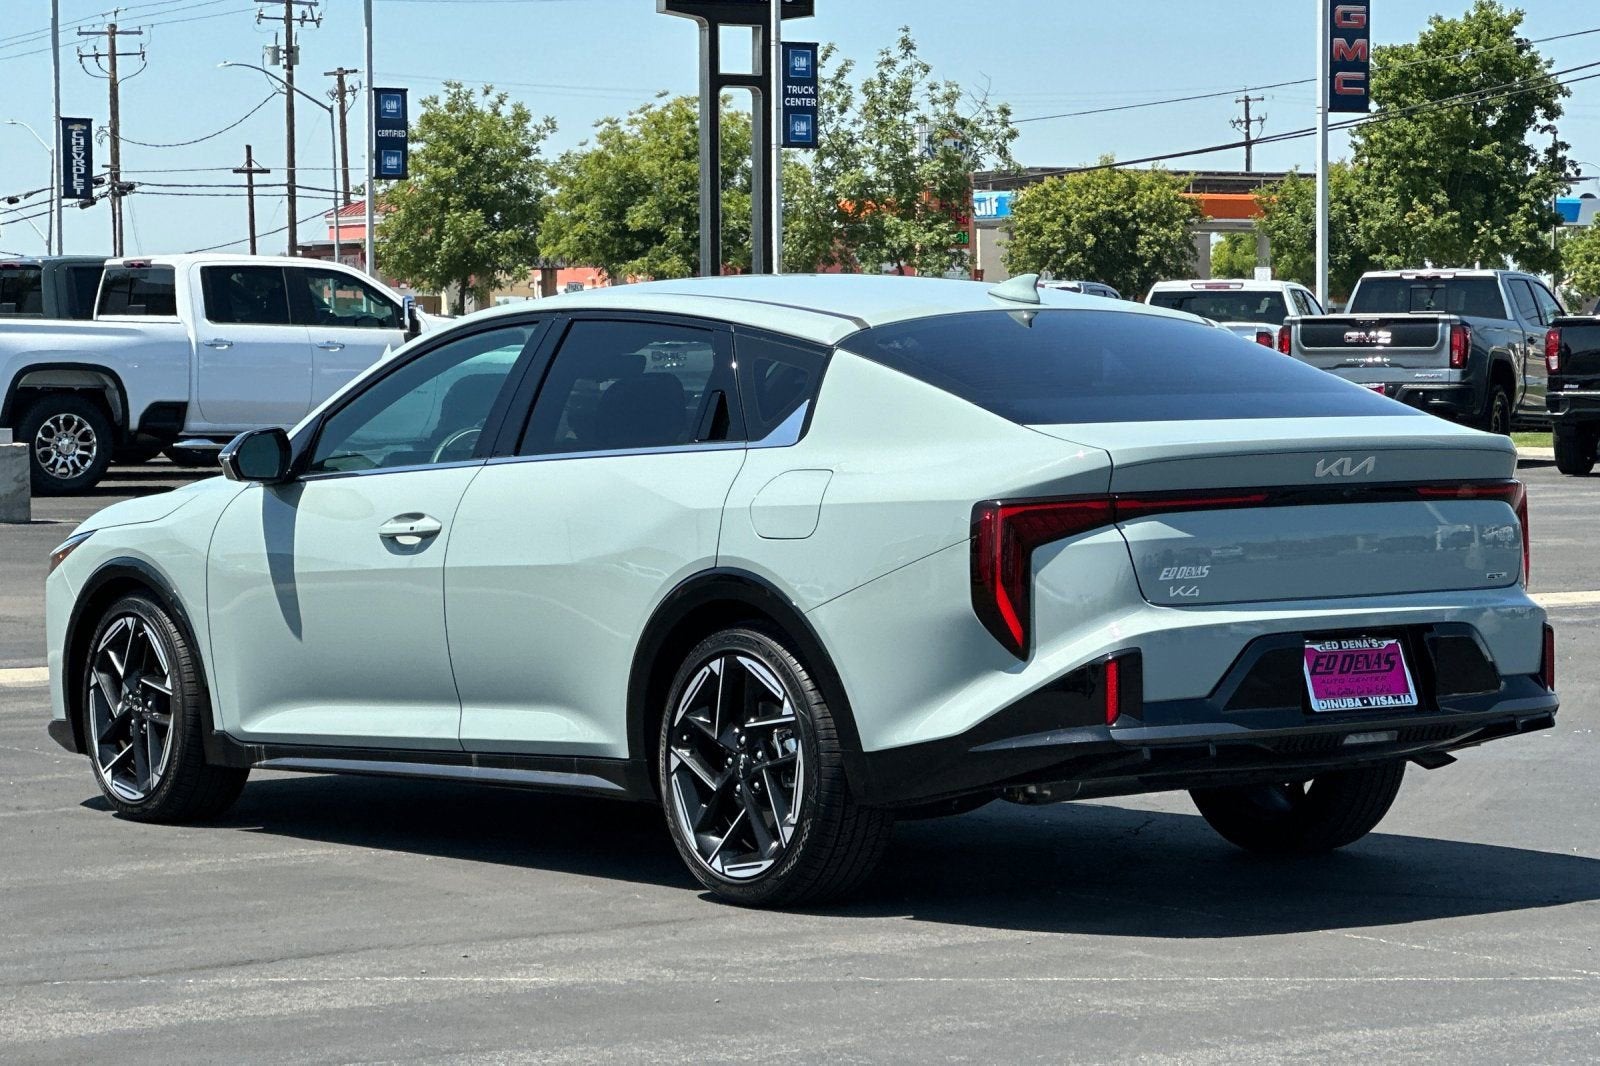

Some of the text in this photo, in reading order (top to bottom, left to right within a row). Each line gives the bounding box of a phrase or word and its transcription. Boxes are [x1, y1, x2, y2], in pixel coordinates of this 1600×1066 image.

[1333, 5, 1367, 95] GMC
[795, 57, 807, 67] GM
[787, 85, 814, 94] TRUCK
[385, 100, 397, 110] GM
[785, 97, 817, 107] CENTER
[795, 121, 807, 132] GM
[377, 129, 406, 138] CERTIFIED
[71, 130, 86, 195] CHEVROLET
[386, 156, 398, 166] GM
[974, 196, 999, 216] ulf
[1343, 330, 1392, 344] GMC
[1314, 456, 1376, 477] KIA
[1169, 585, 1200, 597] K4
[1324, 638, 1378, 650] ED DENA'S
[1319, 694, 1413, 710] DINUBA VISALIA
